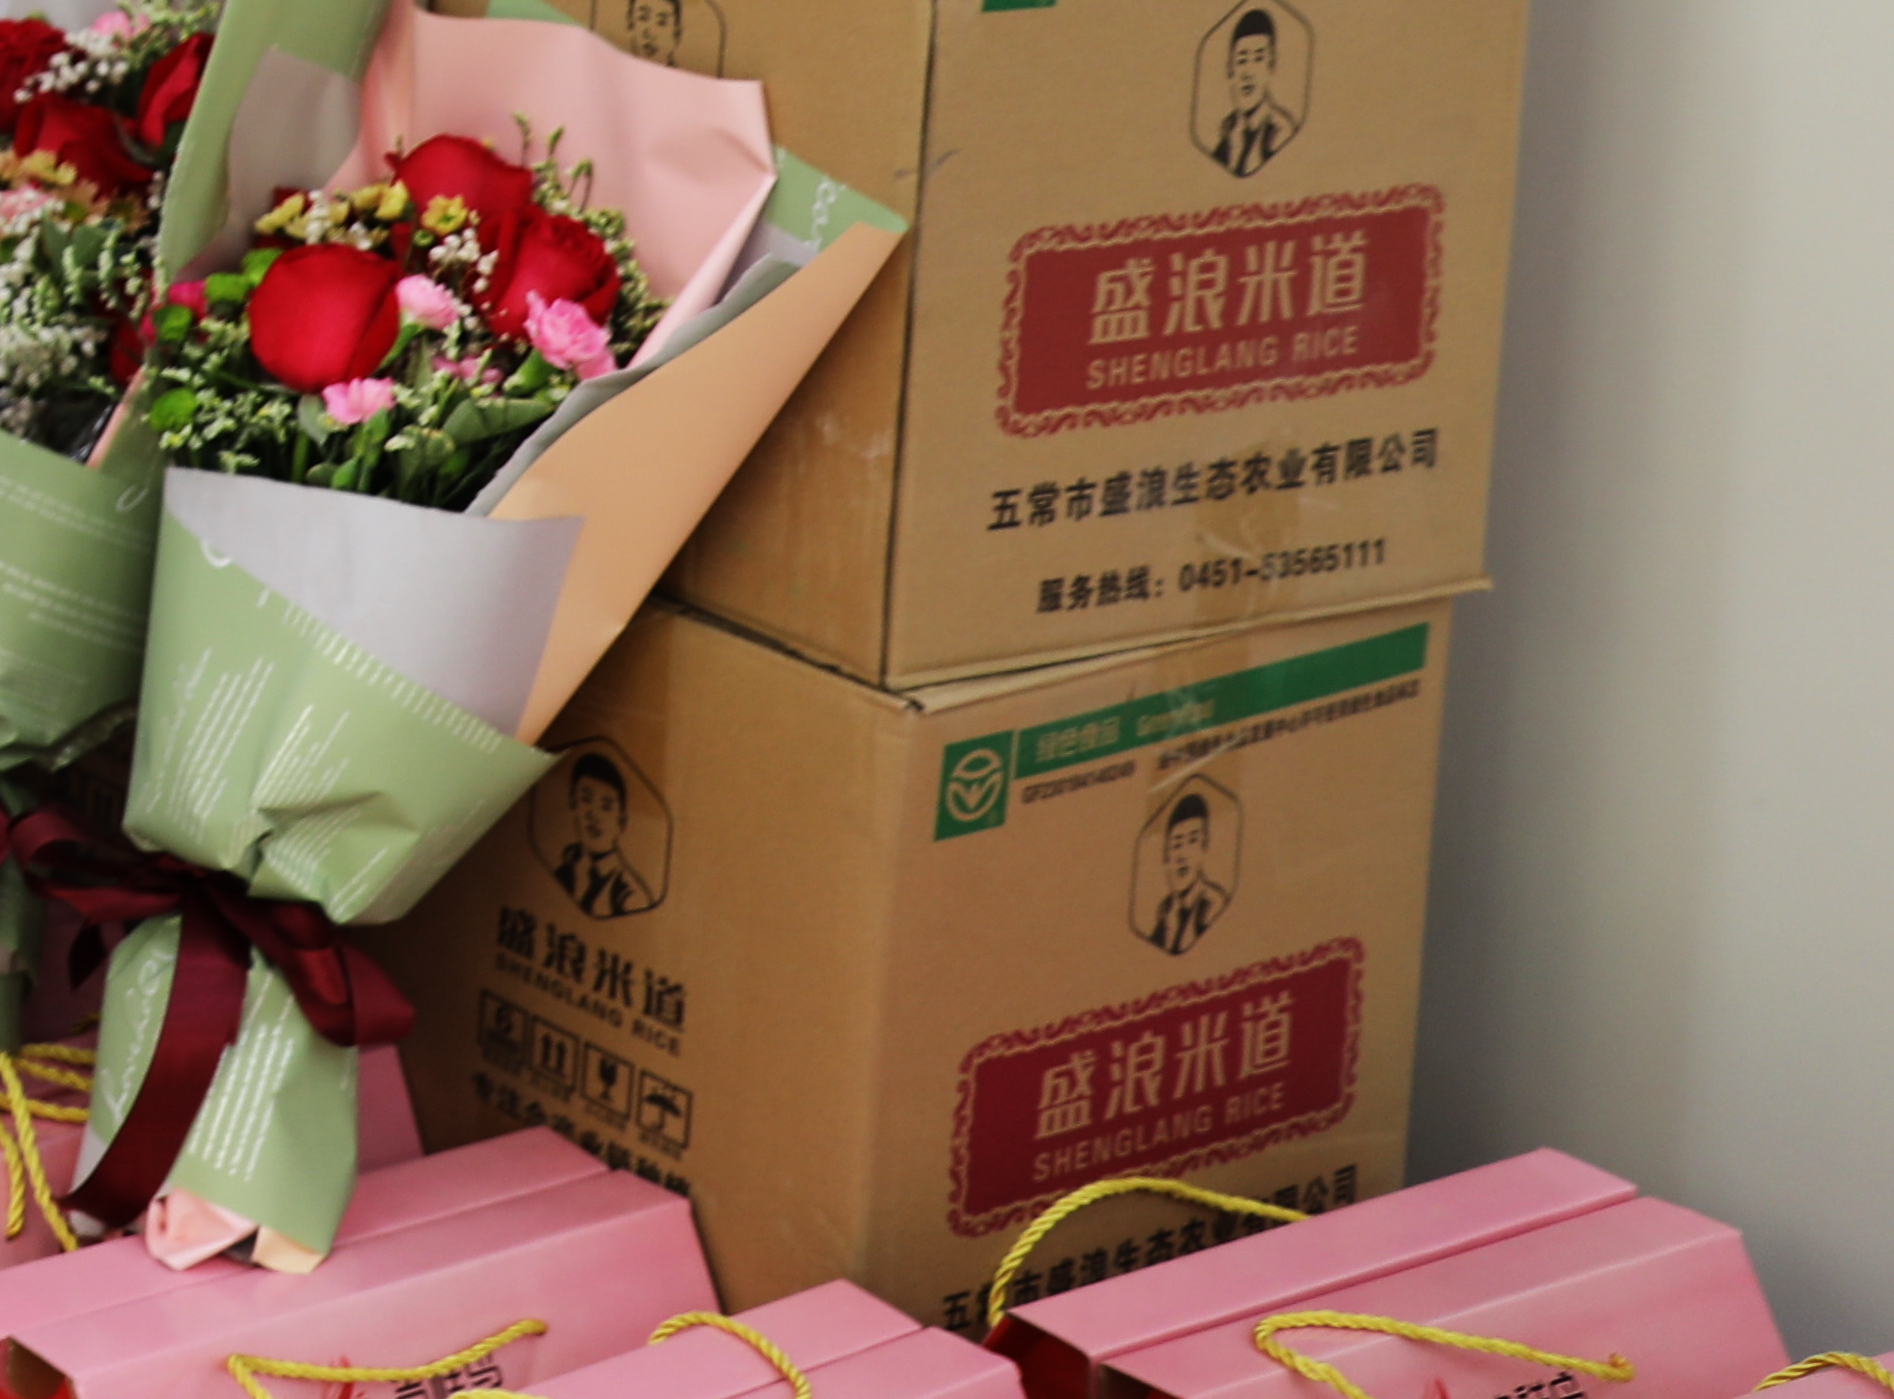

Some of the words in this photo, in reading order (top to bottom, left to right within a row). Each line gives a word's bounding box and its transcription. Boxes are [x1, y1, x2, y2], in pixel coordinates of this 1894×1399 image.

[1086, 228, 1371, 347] 盛浪米道
[1086, 336, 1279, 391] SHENGLANG
[1292, 325, 1360, 363] RICE
[987, 428, 1440, 532] 五常市盛浪生态农业有限公司
[495, 953, 625, 1029] SHENGLANG
[632, 1018, 682, 1057] RICE
[497, 906, 687, 1028] 盛浪米道
[1034, 992, 1297, 1141] 盛浪米道
[1032, 1105, 1214, 1184] SHENGLANG
[1224, 1081, 1287, 1128] RICE
